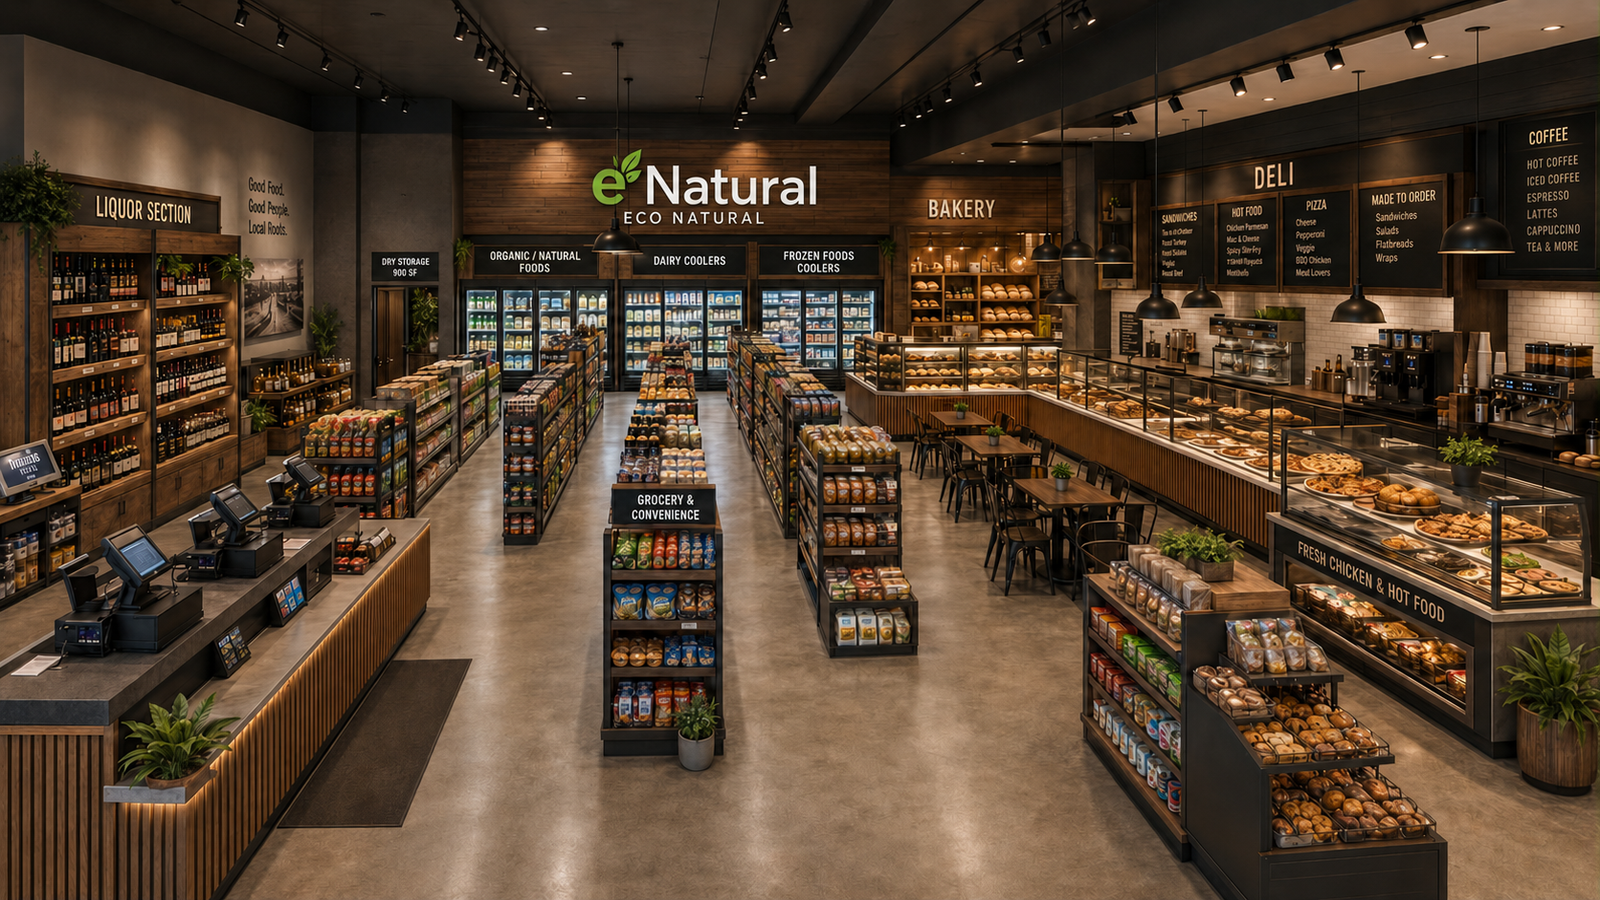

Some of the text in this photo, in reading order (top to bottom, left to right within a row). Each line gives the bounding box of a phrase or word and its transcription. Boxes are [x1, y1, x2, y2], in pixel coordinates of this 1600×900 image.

[1529, 126, 1568, 145] COFFEE
[1527, 154, 1578, 170] HOT COFFEE
[1254, 162, 1293, 190] DELI
[1527, 172, 1580, 186] ICED COFFEE
[248, 176, 285, 196] Good Food.
[646, 165, 817, 205] Natural
[1372, 189, 1436, 206] MADE TO ORDER
[1527, 190, 1570, 203] ESPRESSO
[96, 195, 191, 224] LIQUOR SECTION
[248, 198, 290, 218] Good People.
[929, 198, 995, 218] BAKERY
[1306, 199, 1327, 211] PIZZA
[1232, 205, 1262, 218] HOT FOOD
[1376, 211, 1418, 222] Sandwiches
[1527, 208, 1558, 220] LATTES
[623, 211, 764, 225] ECO NATURAL
[1296, 218, 1316, 227] Cheese
[248, 219, 288, 236] Local Roots.
[1376, 226, 1400, 236] Salads
[1527, 223, 1580, 236] CAPPUCCINO
[1296, 230, 1325, 240] Pepperoni
[1376, 238, 1414, 249] Flatbreads
[1526, 240, 1578, 252] TEA & MORE
[490, 250, 581, 261] ORGANIC / NATURAL
[654, 256, 726, 266] DAIRY COOLERS
[784, 250, 854, 261] FROZEN FOODS
[1375, 253, 1398, 264] Wraps
[382, 258, 430, 266] DRY STORAGE
[520, 263, 550, 273] FOODS
[797, 263, 840, 273] COOLERS
[392, 268, 417, 277] 900 SF
[1311, 268, 1331, 276] Lovers
[637, 494, 694, 506] GROCERY &
[632, 509, 700, 520] CONVENIENCE
[1298, 540, 1445, 623] FRESH CHICKEN & HOT FOOD
